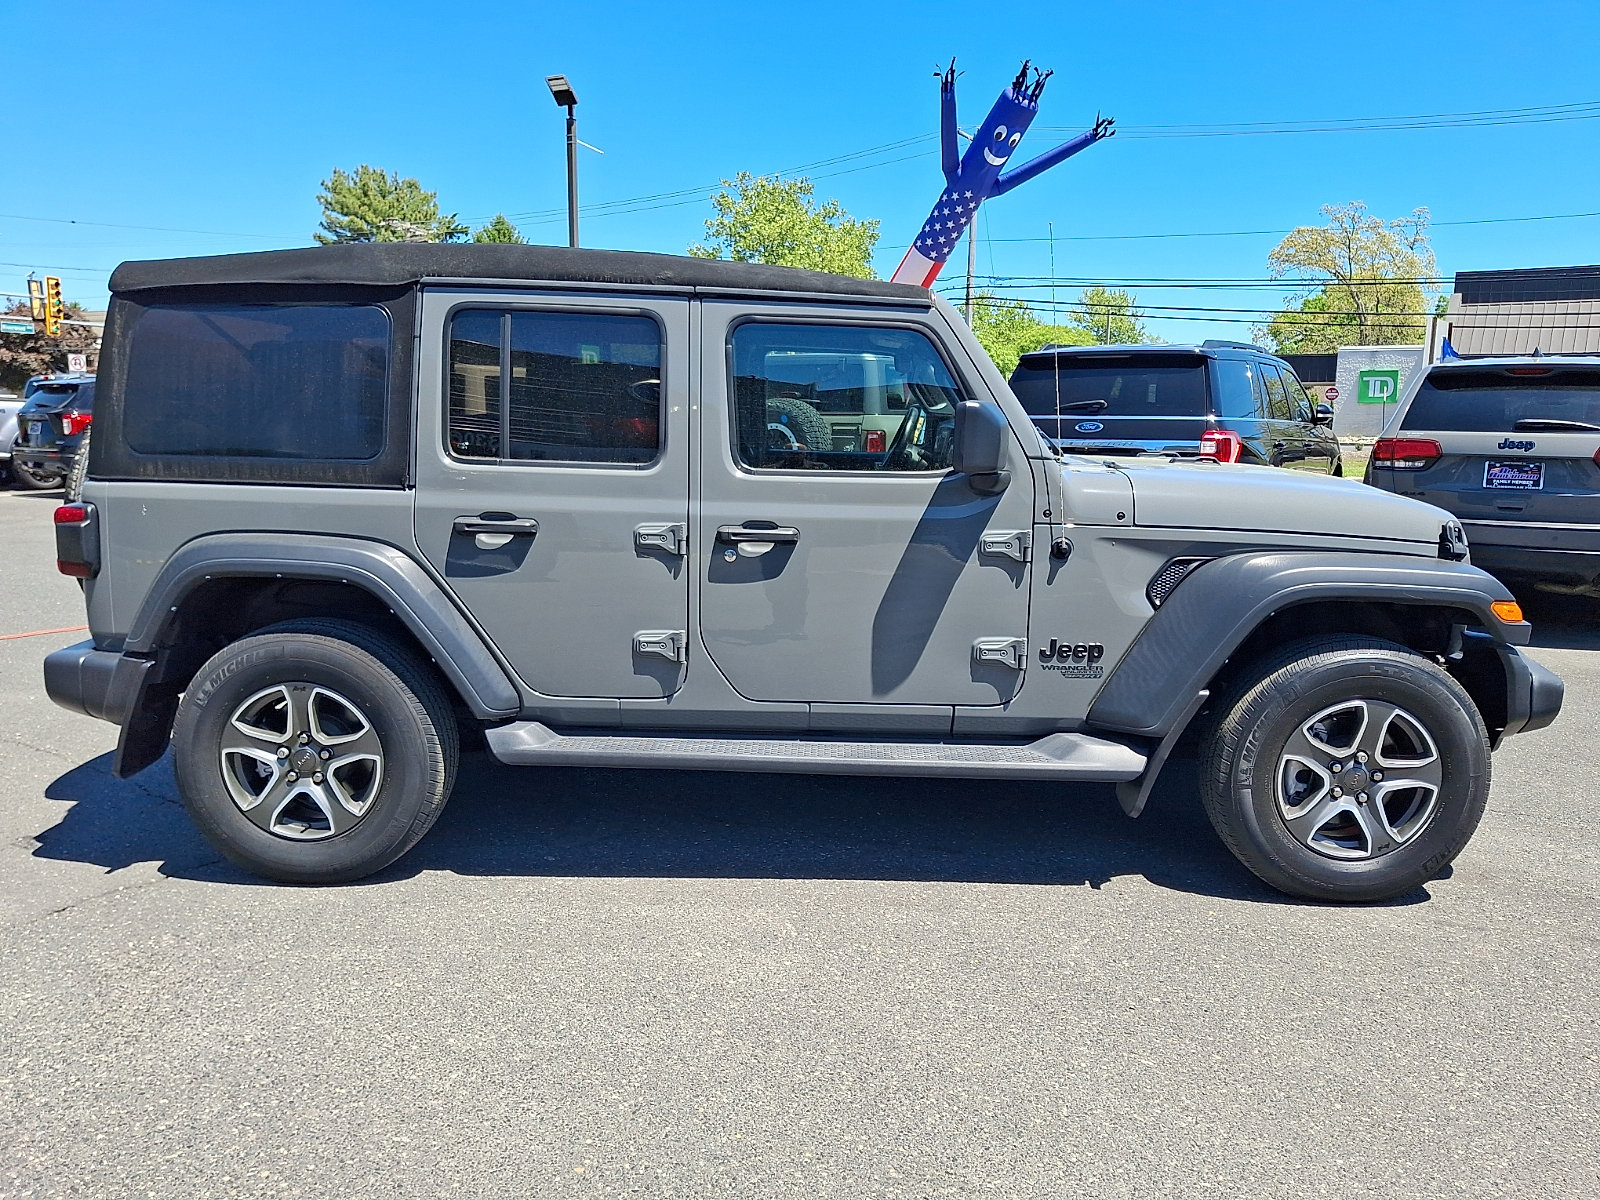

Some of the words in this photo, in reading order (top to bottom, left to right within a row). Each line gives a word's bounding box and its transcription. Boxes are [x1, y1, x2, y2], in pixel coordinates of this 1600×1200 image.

[1363, 376, 1395, 398] TD
[1498, 437, 1535, 452] Jeep
[1039, 637, 1104, 664] Jeep
